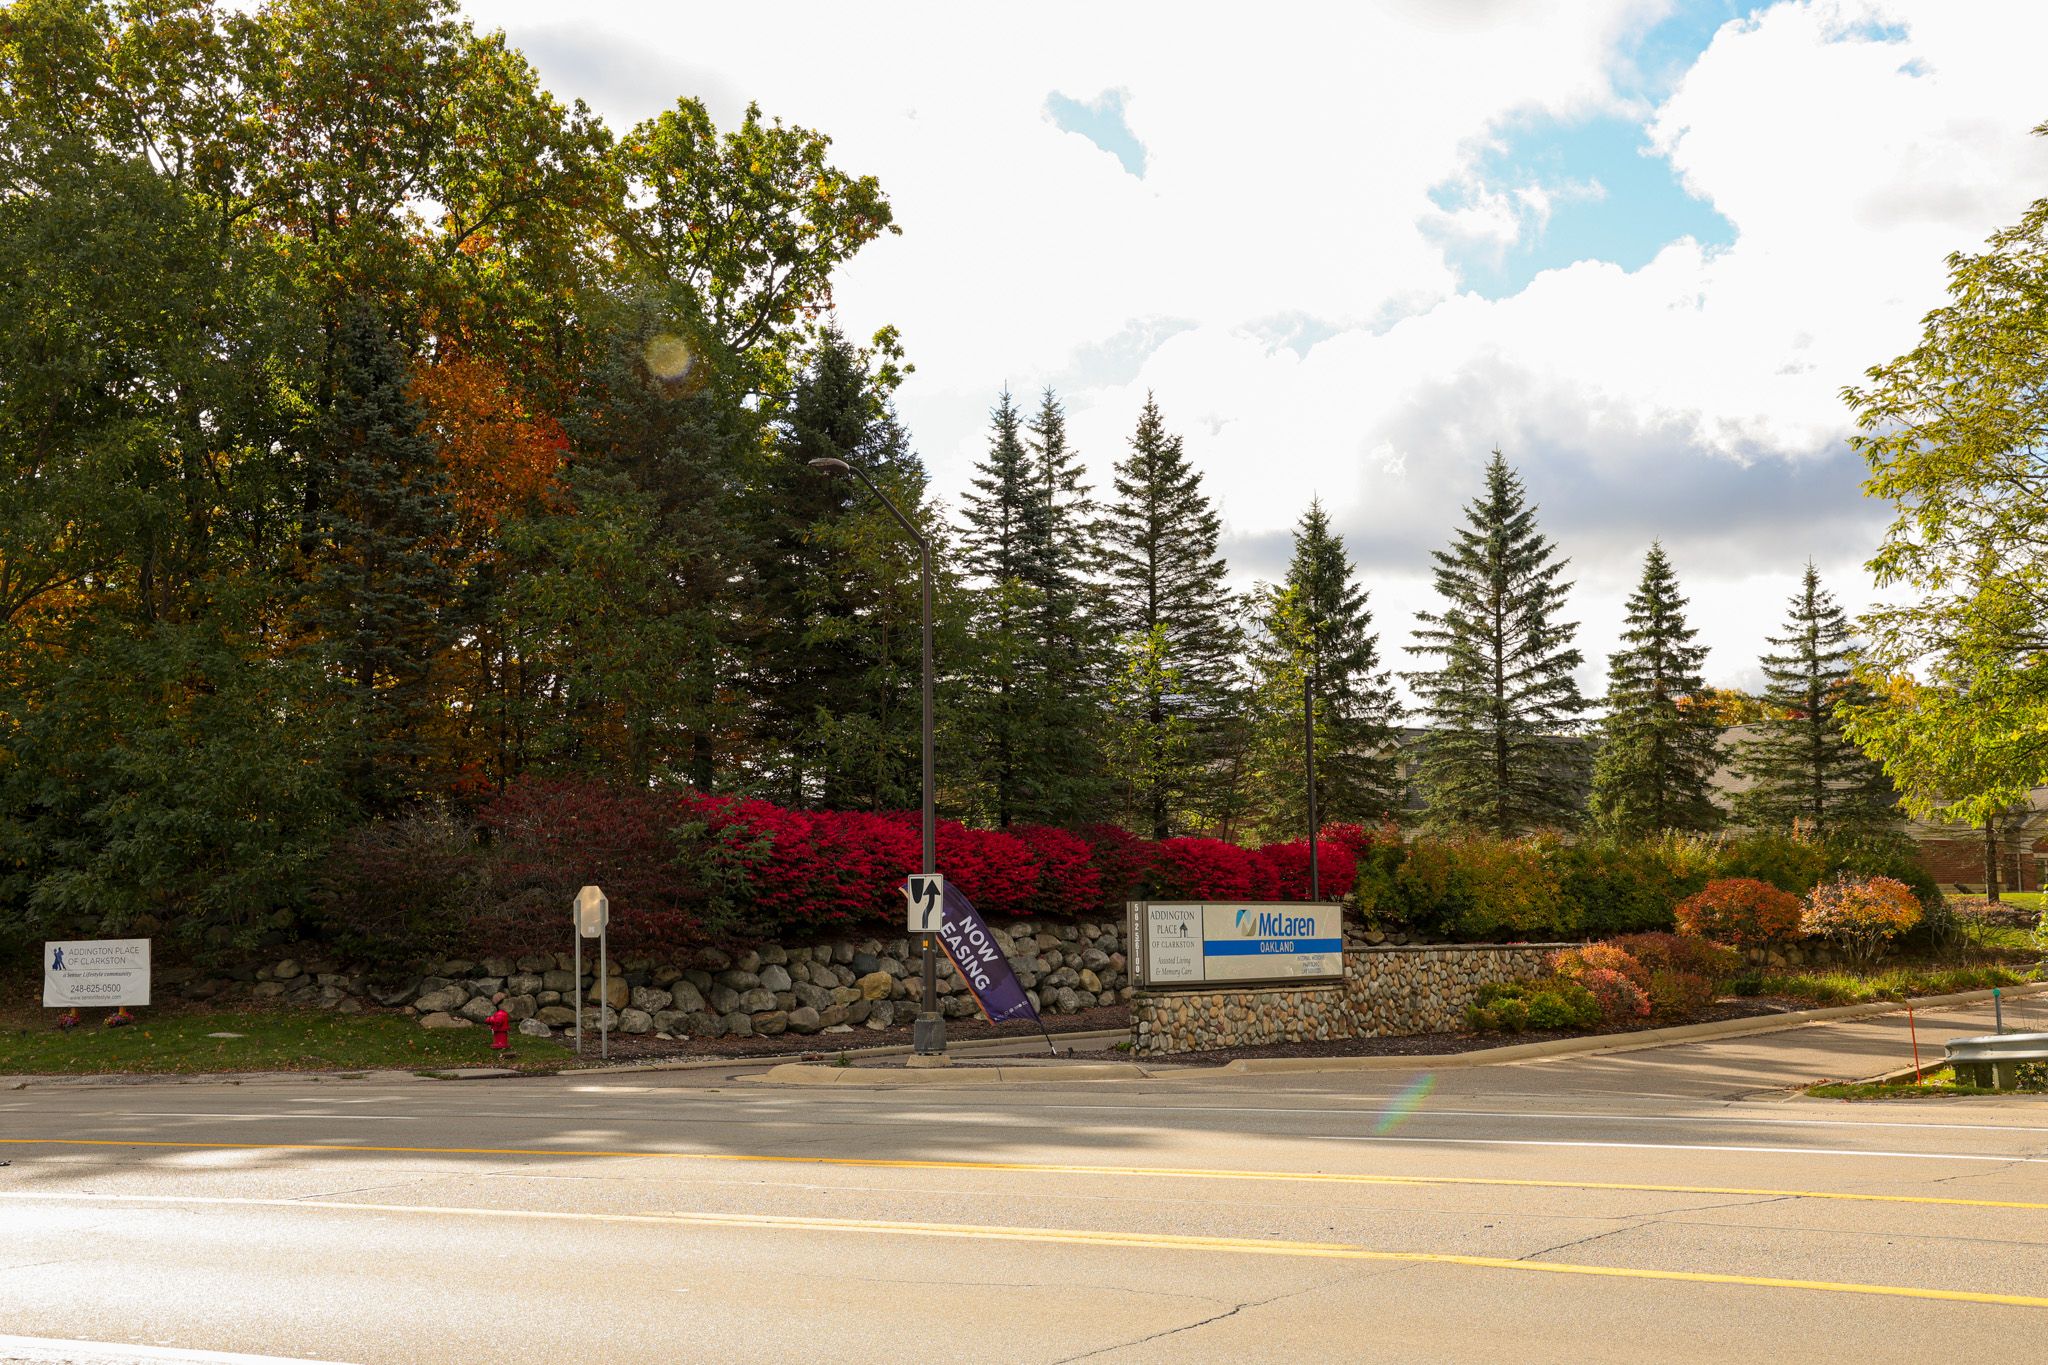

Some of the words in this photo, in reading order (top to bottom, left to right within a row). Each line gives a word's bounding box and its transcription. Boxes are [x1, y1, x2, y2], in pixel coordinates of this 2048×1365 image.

[1150, 910, 1195, 920] ADDINGTON
[1156, 924, 1178, 934] PLACE
[1258, 912, 1315, 937] McLaren
[959, 915, 999, 963] NOW
[1151, 940, 1160, 948] OF
[1161, 940, 1195, 948] CLARKSTON
[68, 946, 114, 957] ADDINGTON
[115, 945, 140, 955] PLACE
[940, 911, 991, 991] EASING
[1260, 942, 1295, 953] OAKLAND
[80, 956, 126, 966] CLARKSTON
[70, 983, 122, 994] 248-625-0500
